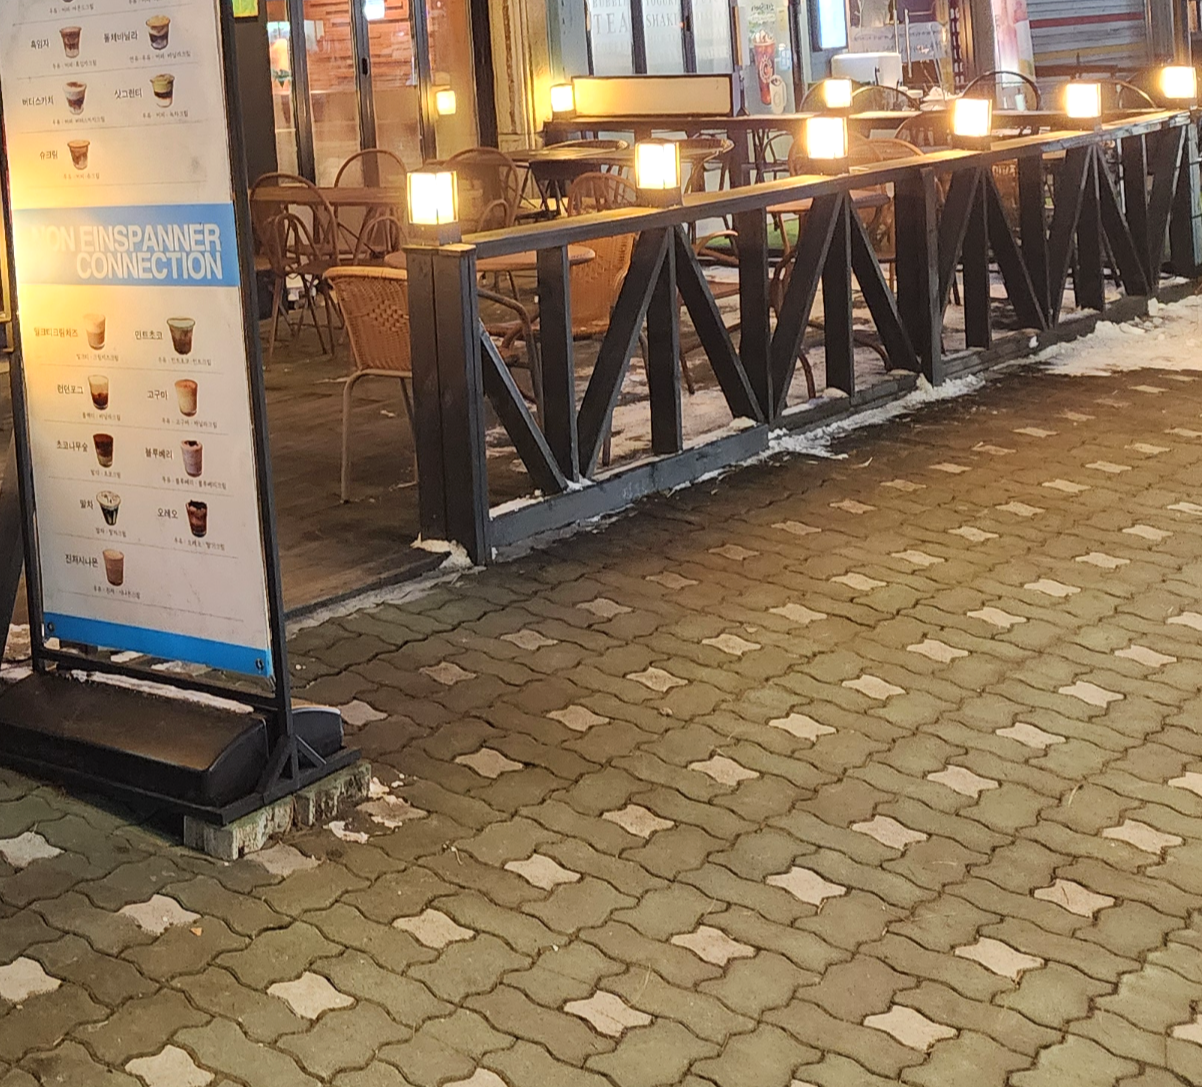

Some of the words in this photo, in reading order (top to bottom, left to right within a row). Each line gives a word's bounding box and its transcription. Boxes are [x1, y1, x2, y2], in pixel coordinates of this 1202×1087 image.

[593, 11, 629, 34] TEA
[79, 223, 222, 253] EINSPANNER
[76, 252, 223, 280] CONNECTION
[134, 329, 163, 341] 민트초코
[147, 389, 168, 400] 고구마
[56, 440, 88, 453] 초코나무숲
[145, 447, 174, 460] 블루베리
[157, 508, 179, 519] 오레오
